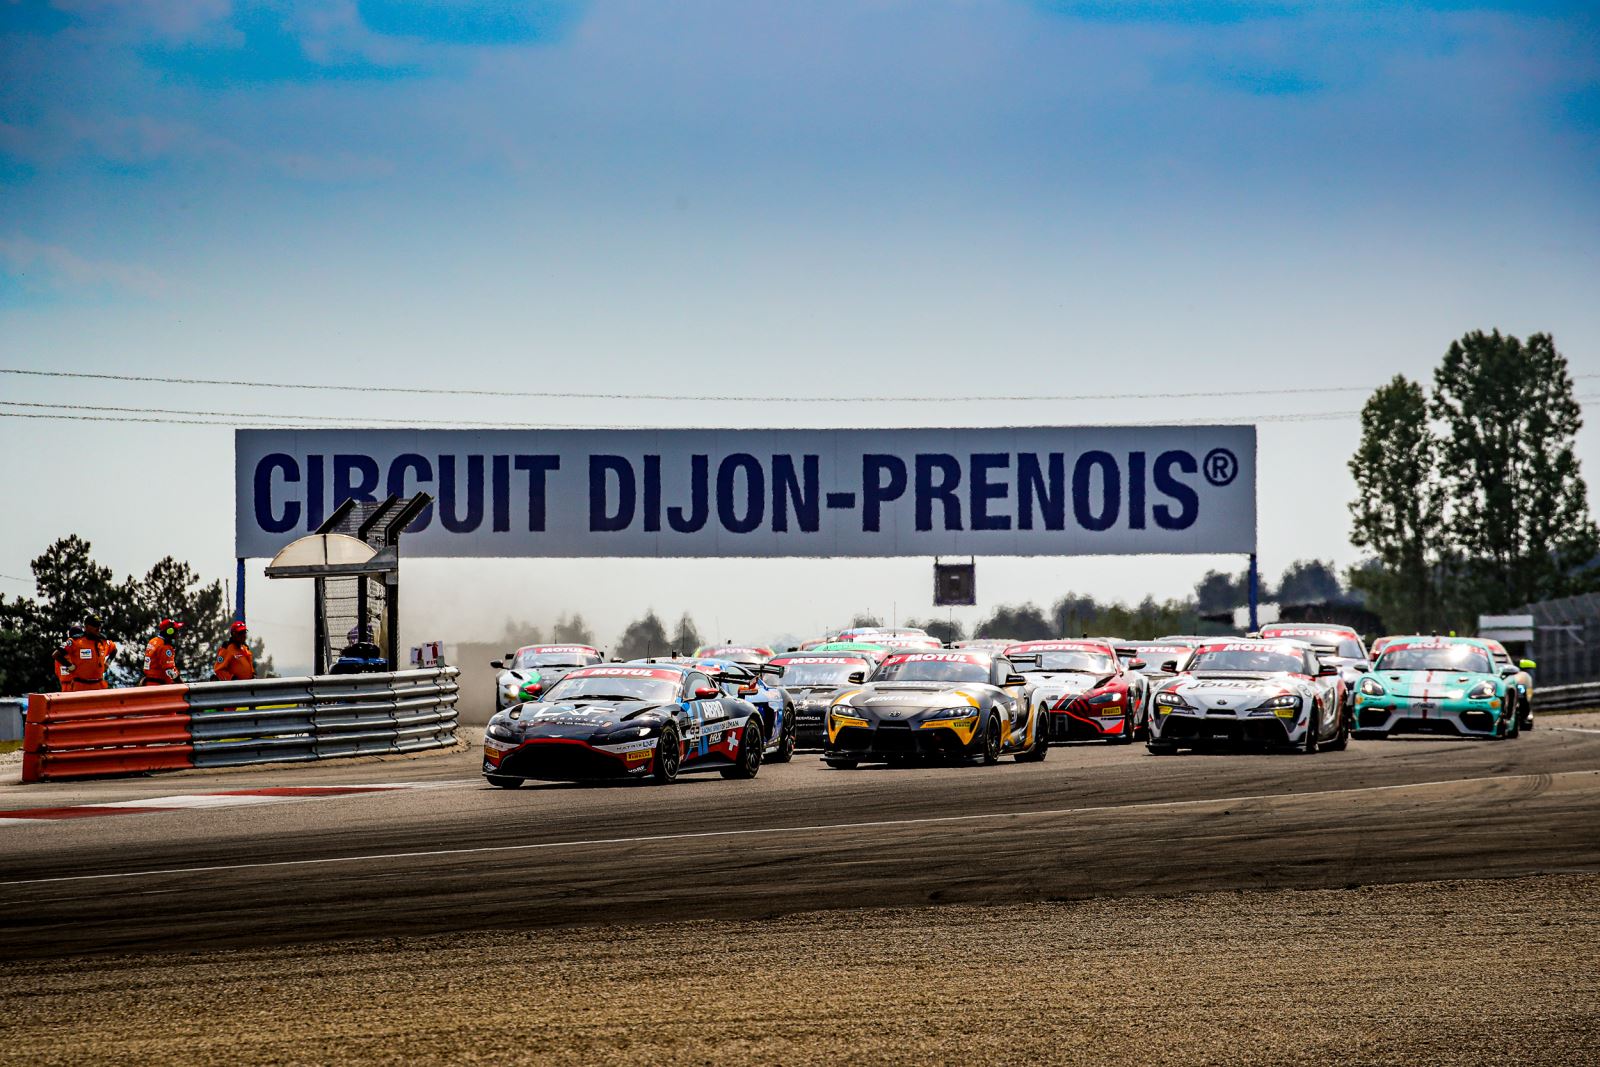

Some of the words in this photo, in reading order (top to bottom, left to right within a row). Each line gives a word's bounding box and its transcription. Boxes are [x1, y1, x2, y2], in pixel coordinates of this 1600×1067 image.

[253, 453, 560, 533] CIRCUIT
[905, 653, 968, 662] MOTUL
[590, 668, 653, 677] MOTUL
[628, 751, 650, 760] PIRELLI
